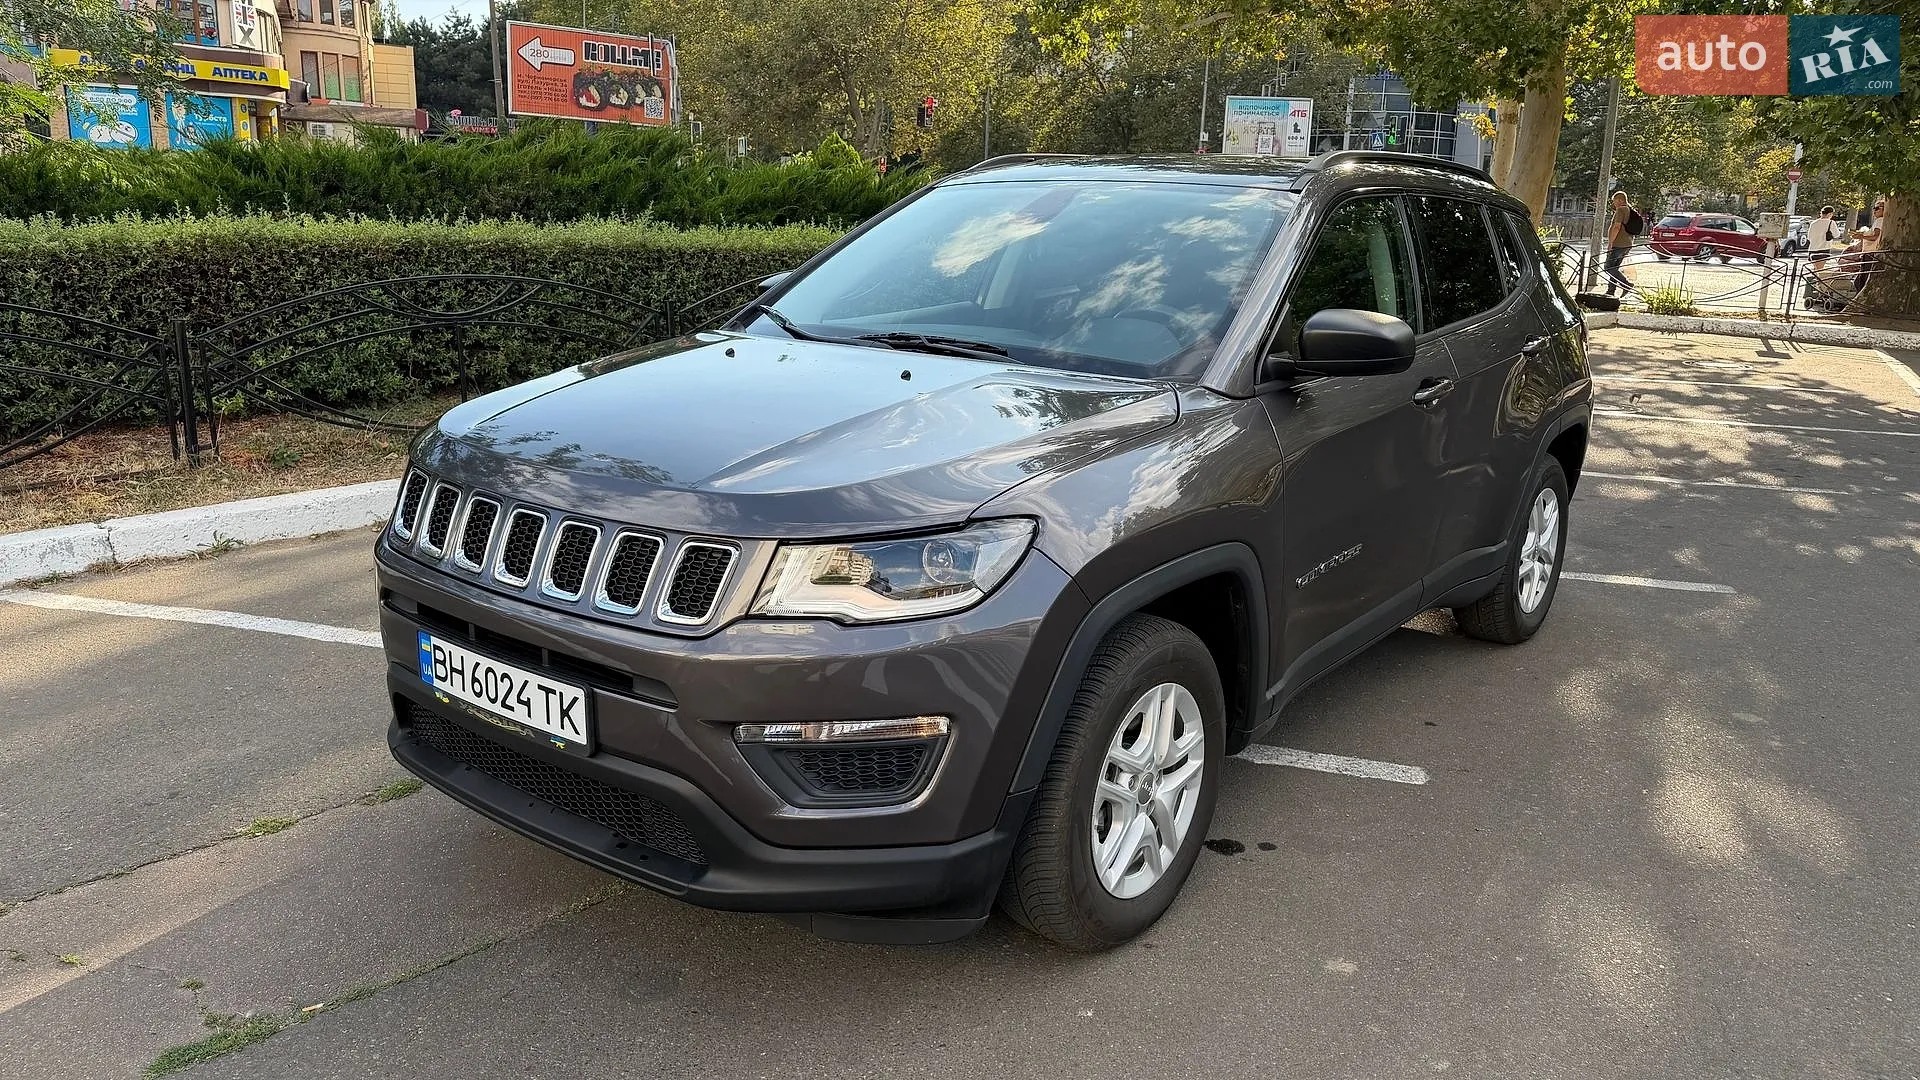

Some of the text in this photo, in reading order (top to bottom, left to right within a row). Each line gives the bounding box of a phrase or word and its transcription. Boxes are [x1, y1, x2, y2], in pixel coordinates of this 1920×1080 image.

[529, 48, 550, 58] 280
[212, 66, 269, 82] АПТЕКА
[1289, 109, 1308, 118] АТБ
[422, 663, 433, 676] UA
[432, 643, 466, 692] BH
[471, 661, 532, 719] 6024
[537, 683, 581, 736] TK
